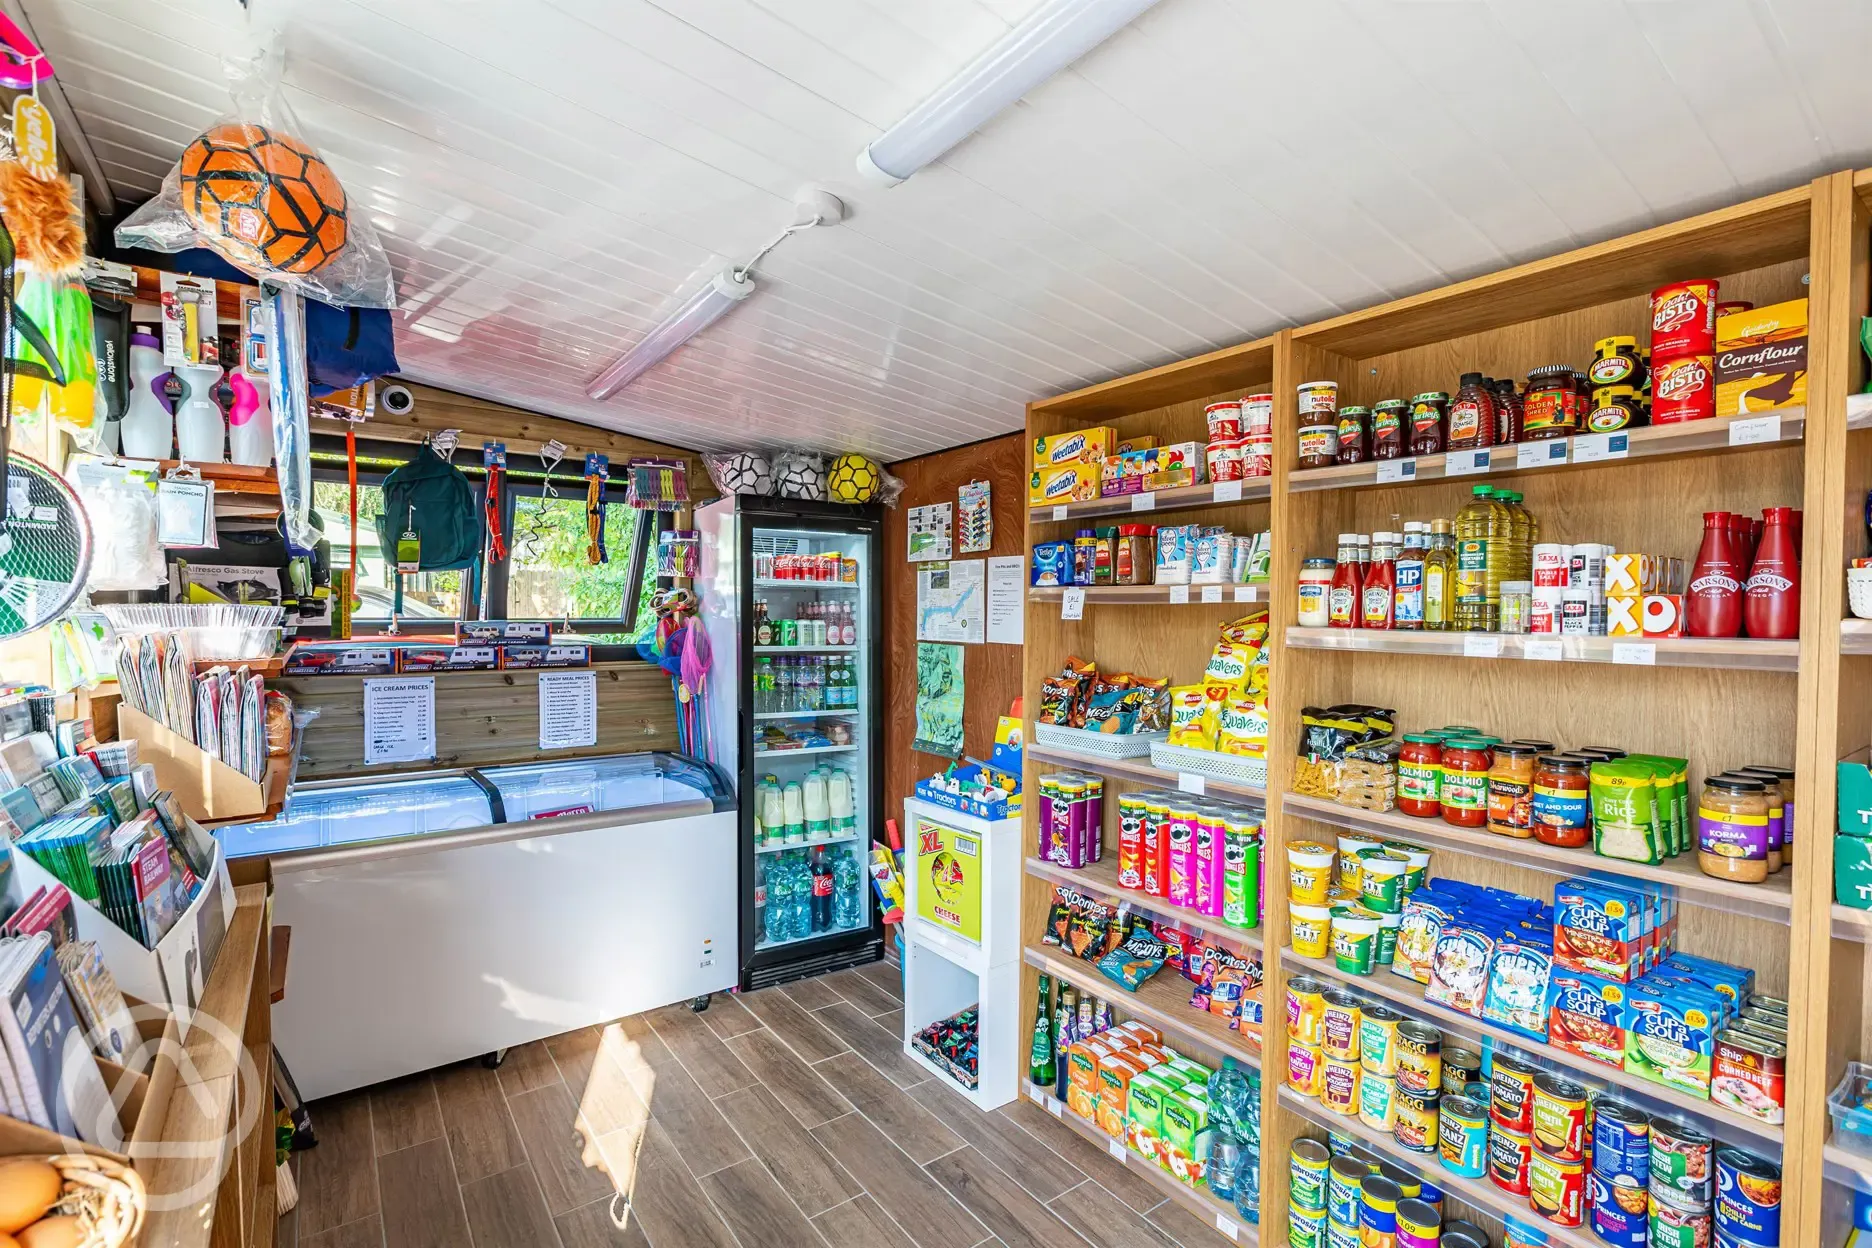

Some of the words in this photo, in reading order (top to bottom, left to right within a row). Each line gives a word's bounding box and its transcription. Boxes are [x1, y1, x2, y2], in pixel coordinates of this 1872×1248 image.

[23, 106, 45, 163] yello
[1663, 291, 1691, 309] aah!
[1653, 298, 1699, 328] BISTO
[1741, 320, 1779, 337] Goldenfry
[1594, 358, 1628, 370] MARMITE
[1719, 345, 1803, 369] Cornflour
[1672, 361, 1699, 377] aah!
[1658, 369, 1706, 398] BISTO
[1311, 395, 1335, 403] nutella
[1524, 400, 1553, 412] GOLDEN
[1526, 407, 1549, 417] SHRED
[1592, 408, 1625, 420] MARMITE
[1452, 419, 1474, 429] Rowse
[1052, 438, 1086, 462] Weetabix
[1301, 439, 1326, 447] nutella
[1215, 461, 1228, 469] OAT
[1045, 472, 1078, 495] Weetabix
[177, 490, 204, 498] PONCHO
[1538, 553, 1559, 563] SAXA
[187, 565, 222, 574] Alfresco
[224, 566, 238, 574] Gas
[241, 567, 264, 576] Stove
[1396, 569, 1420, 585] HP
[1692, 575, 1738, 592] SARSON'S
[1564, 604, 1584, 612] SAXA
[1222, 712, 1268, 734] Quavers
[1399, 766, 1433, 779] DOLMIO
[1444, 774, 1483, 786] DOLMIO
[1611, 777, 1627, 786] 89p
[934, 790, 957, 806] Tractors
[1545, 803, 1562, 811] AND
[1604, 804, 1637, 818] Rice
[920, 830, 943, 855] XL
[1121, 833, 1141, 843] PRINGLES
[1709, 829, 1747, 840] KORMA
[1170, 842, 1191, 853] PRINGLES
[142, 856, 158, 875] STEAM
[1070, 893, 1108, 917] Doritos
[1606, 904, 1624, 914] £1.59
[934, 906, 961, 923] CHEESE
[1570, 916, 1610, 933] SOUP
[1564, 927, 1613, 947] MINESTRONE
[1204, 947, 1246, 971] Doritos
[1603, 990, 1621, 1000] £1.59
[1327, 1010, 1350, 1021] HEINZ
[1566, 1000, 1607, 1017] SOUP
[1562, 1012, 1610, 1031] MINESTRONE
[1686, 1015, 1706, 1025] £1.59
[1645, 1023, 1690, 1043] SOUP
[1291, 1045, 1311, 1057] HEINZ
[1645, 1043, 1687, 1061] VEGETABLE
[1720, 1047, 1743, 1062] Ship
[1290, 1058, 1312, 1069] RAVIOLI
[1327, 1066, 1351, 1077] HEINZ
[1072, 1071, 1088, 1084] Orange
[1495, 1071, 1521, 1089] HEINZ
[1718, 1064, 1752, 1081] CORNED
[1752, 1073, 1773, 1087] BEEF
[1103, 1089, 1119, 1103] Orange
[1493, 1083, 1523, 1103] TOMATO
[1536, 1096, 1567, 1116] HEINZ
[1537, 1108, 1564, 1127] LENTIL
[1492, 1131, 1516, 1150] HEINZ
[1651, 1156, 1673, 1174] STEW
[1652, 1150, 1671, 1165] IRISH
[1532, 1158, 1559, 1178] HEINZ
[1533, 1170, 1556, 1190] LENTIL
[1720, 1192, 1754, 1214] PRINCES
[1596, 1203, 1626, 1223] PRINCES
[1725, 1207, 1746, 1221] CHILLI
[1657, 1221, 1680, 1238] IRISH
[1726, 1213, 1739, 1224] CON
[1739, 1219, 1763, 1231] CARNE
[1656, 1230, 1681, 1248] STEW
